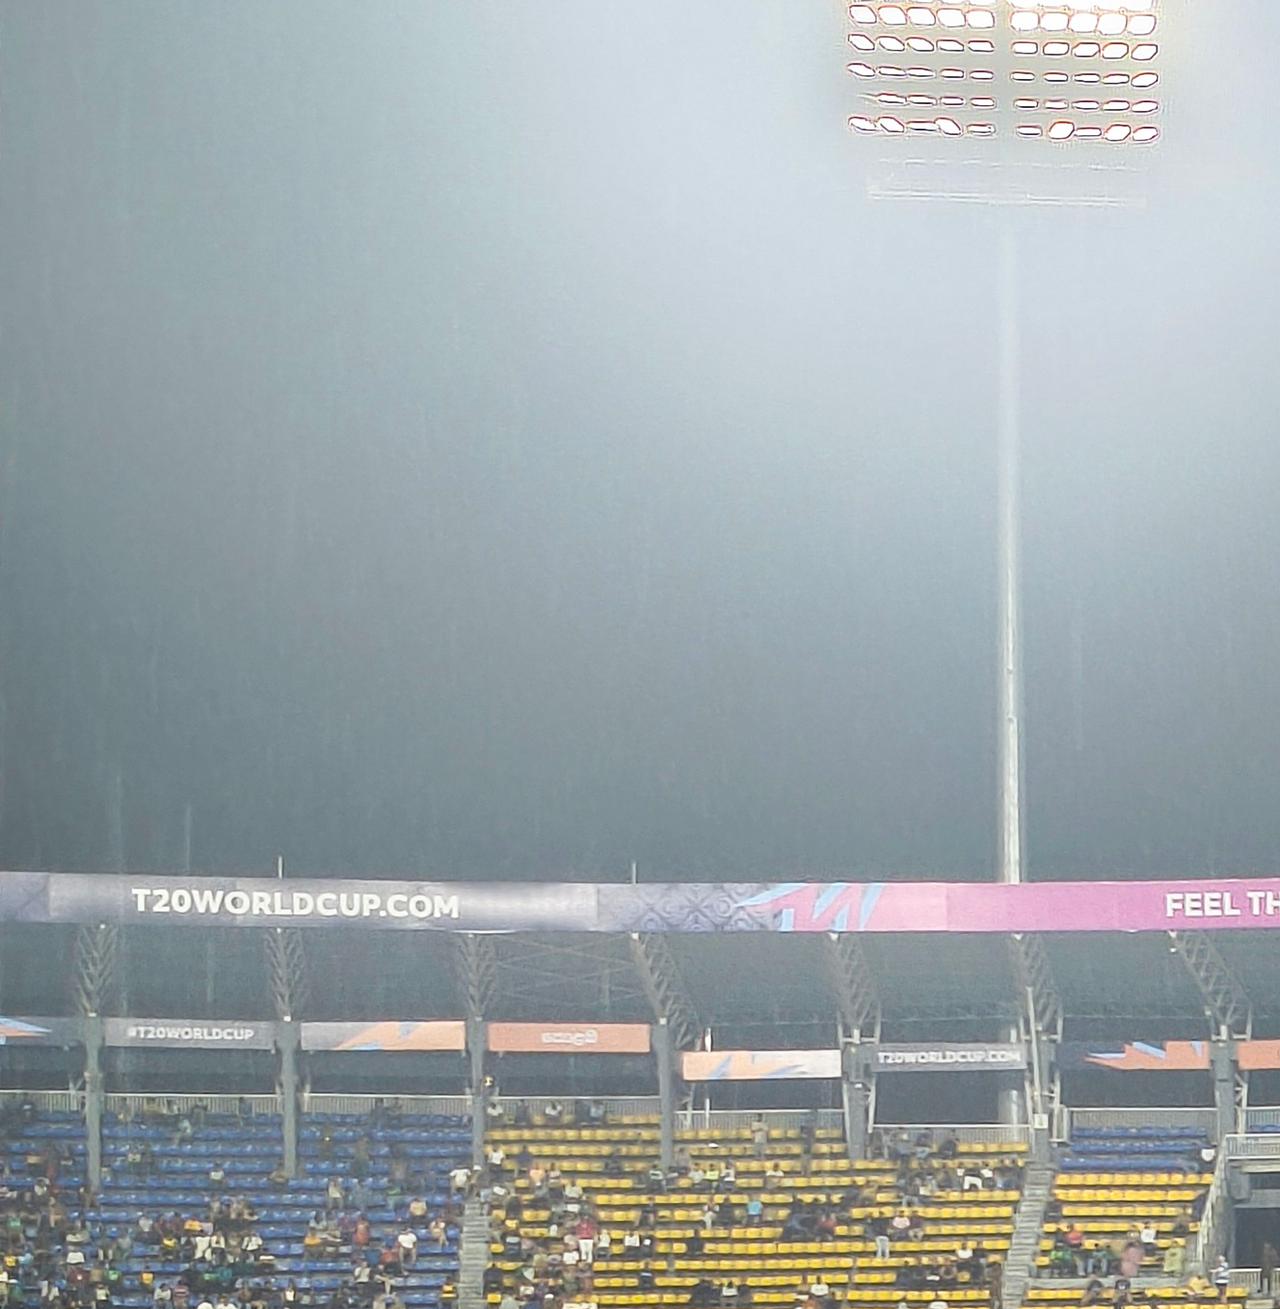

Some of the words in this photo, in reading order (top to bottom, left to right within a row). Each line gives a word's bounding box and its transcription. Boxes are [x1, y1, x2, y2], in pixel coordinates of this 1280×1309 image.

[132, 888, 458, 918] T20WORLDCUP.COM
[1167, 893, 1240, 916] FEEL
[126, 1026, 255, 1040] #T20WORLDCUP
